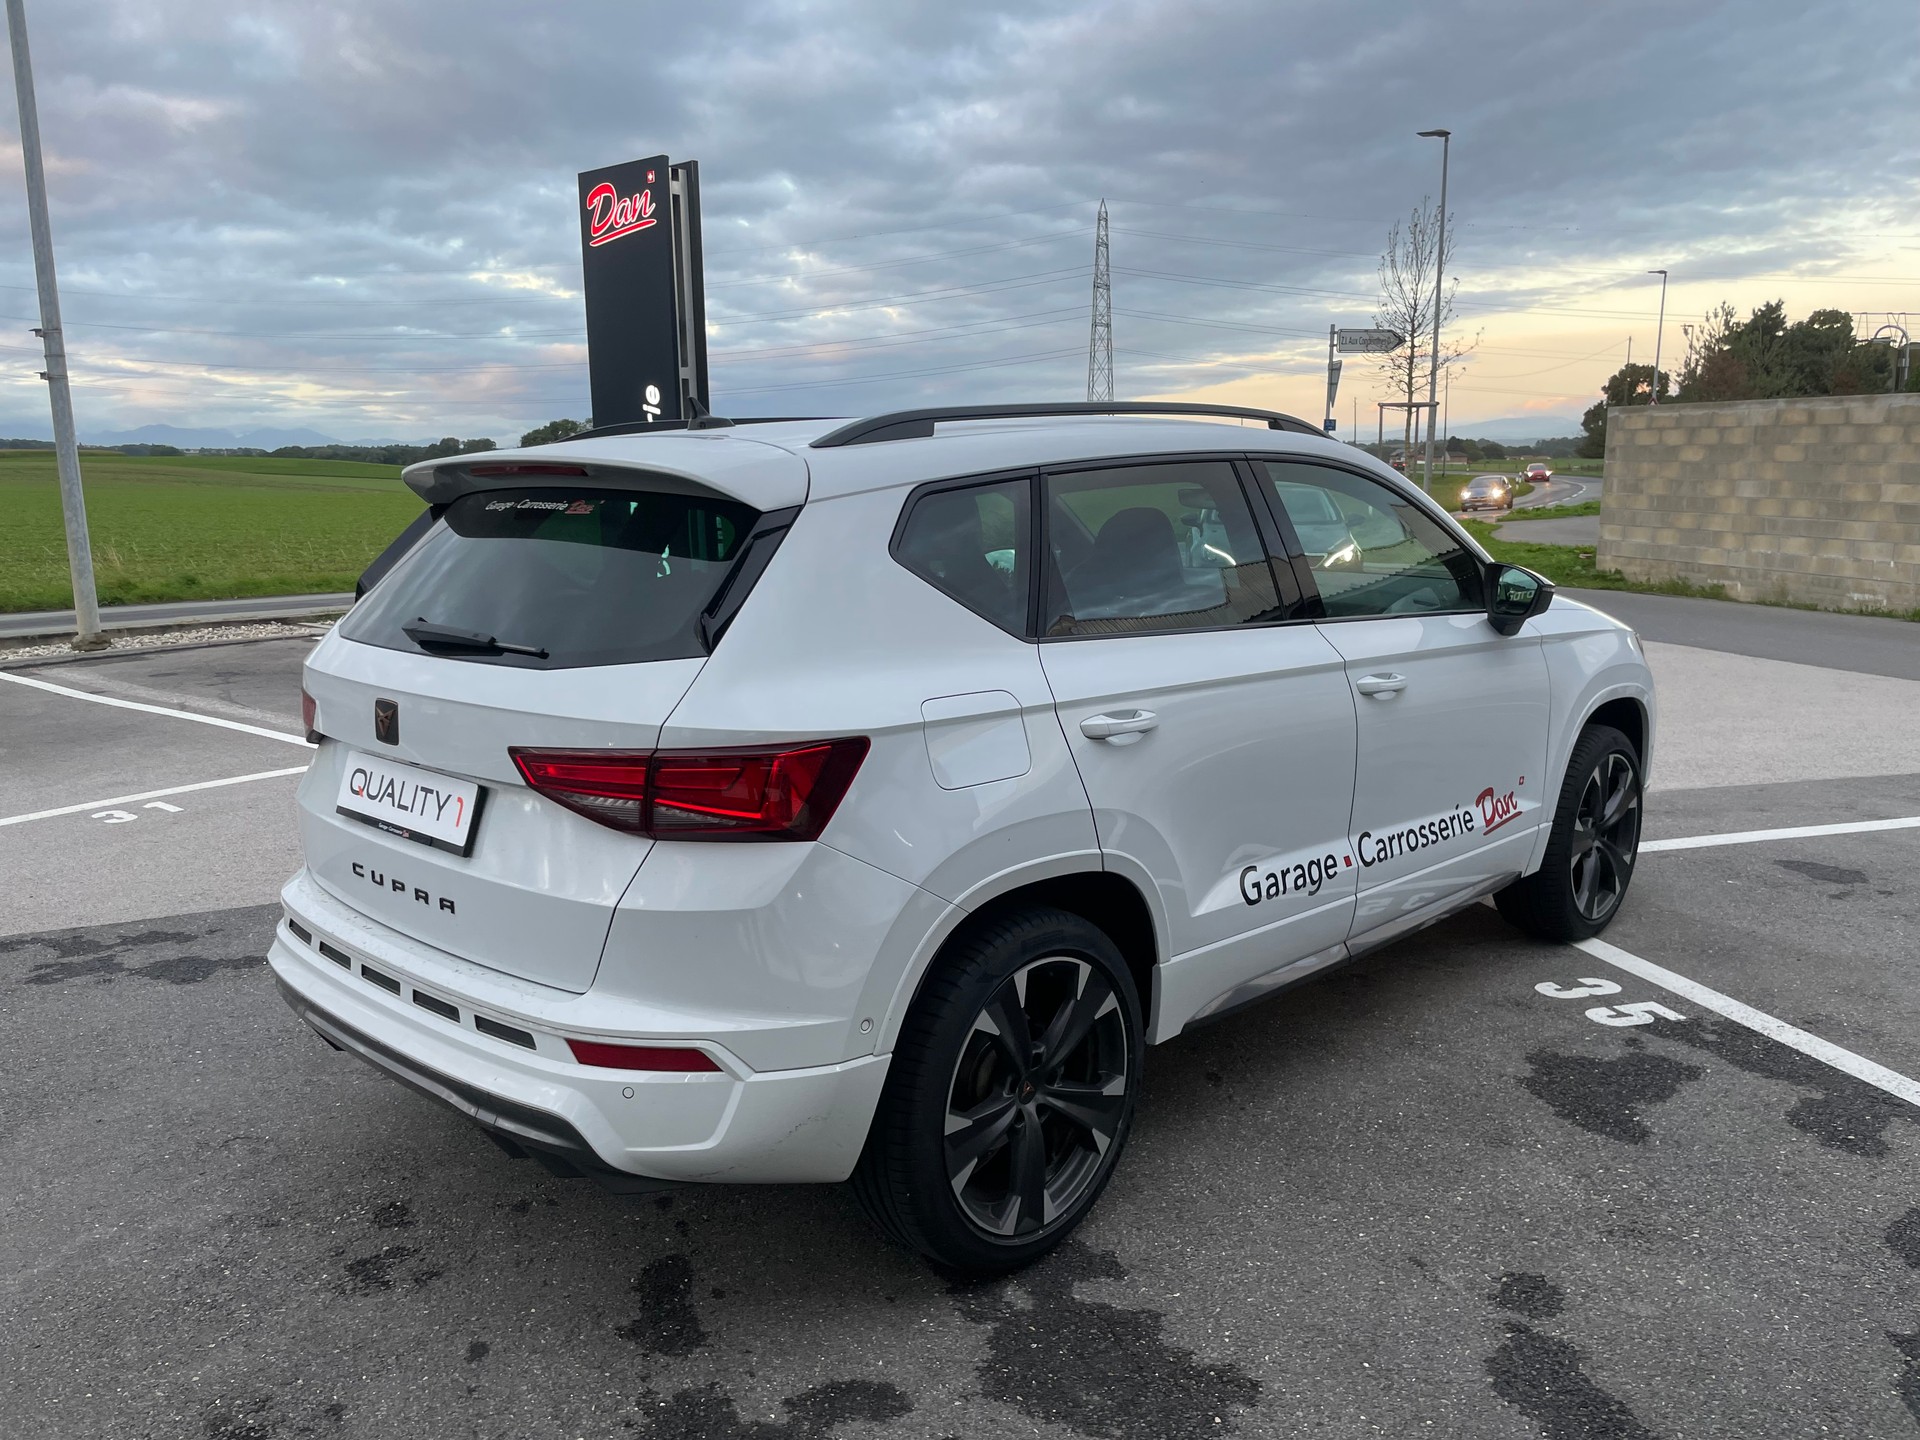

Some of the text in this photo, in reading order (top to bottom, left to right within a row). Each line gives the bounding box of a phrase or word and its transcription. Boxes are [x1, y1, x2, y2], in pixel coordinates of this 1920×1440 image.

[587, 182, 656, 238] Dan
[485, 500, 515, 511] Garage
[517, 499, 568, 510] Carrosserie
[91, 801, 185, 824] 31
[1239, 853, 1338, 906] Garage
[1357, 804, 1474, 868] Carrosserie
[1475, 787, 1518, 829] Dan
[352, 861, 456, 914] CUPRA
[1534, 977, 1687, 1027] 35
